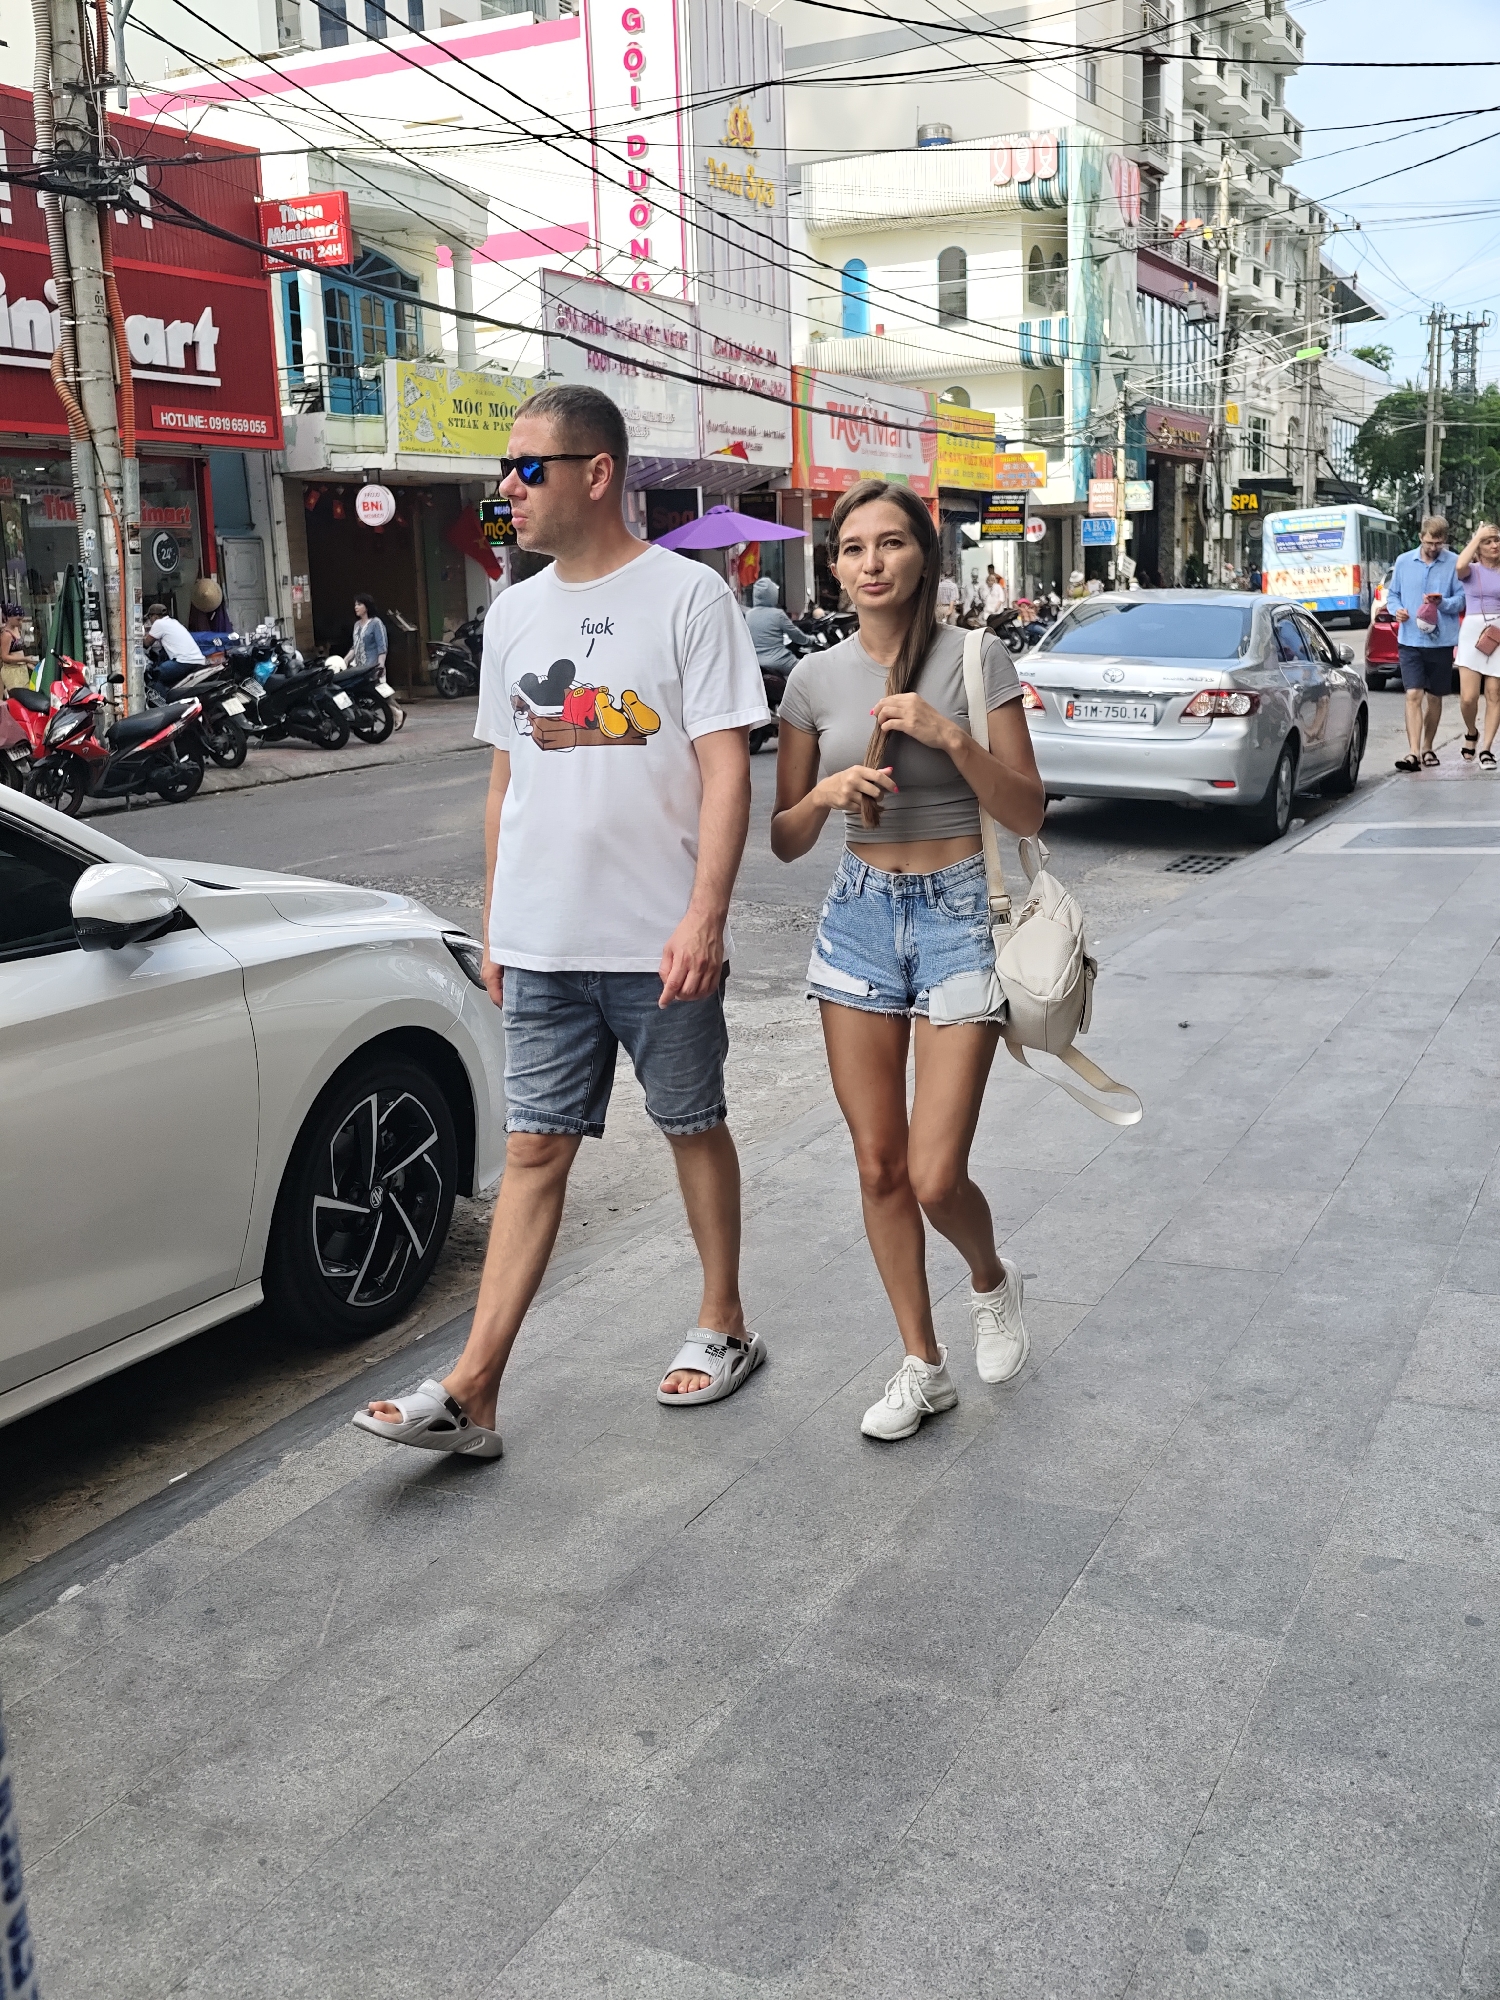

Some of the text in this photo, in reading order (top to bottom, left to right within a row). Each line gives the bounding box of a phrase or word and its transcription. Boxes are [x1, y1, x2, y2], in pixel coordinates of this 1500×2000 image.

[622, 7, 644, 107] GỘI
[317, 243, 342, 258] 24H
[160, 411, 267, 434] HOTLINE: 0919 659 055
[448, 417, 479, 430] STEAK
[1231, 493, 1259, 510] SPA
[581, 616, 615, 636] fuck
[1073, 704, 1148, 720] 51M-750.14
